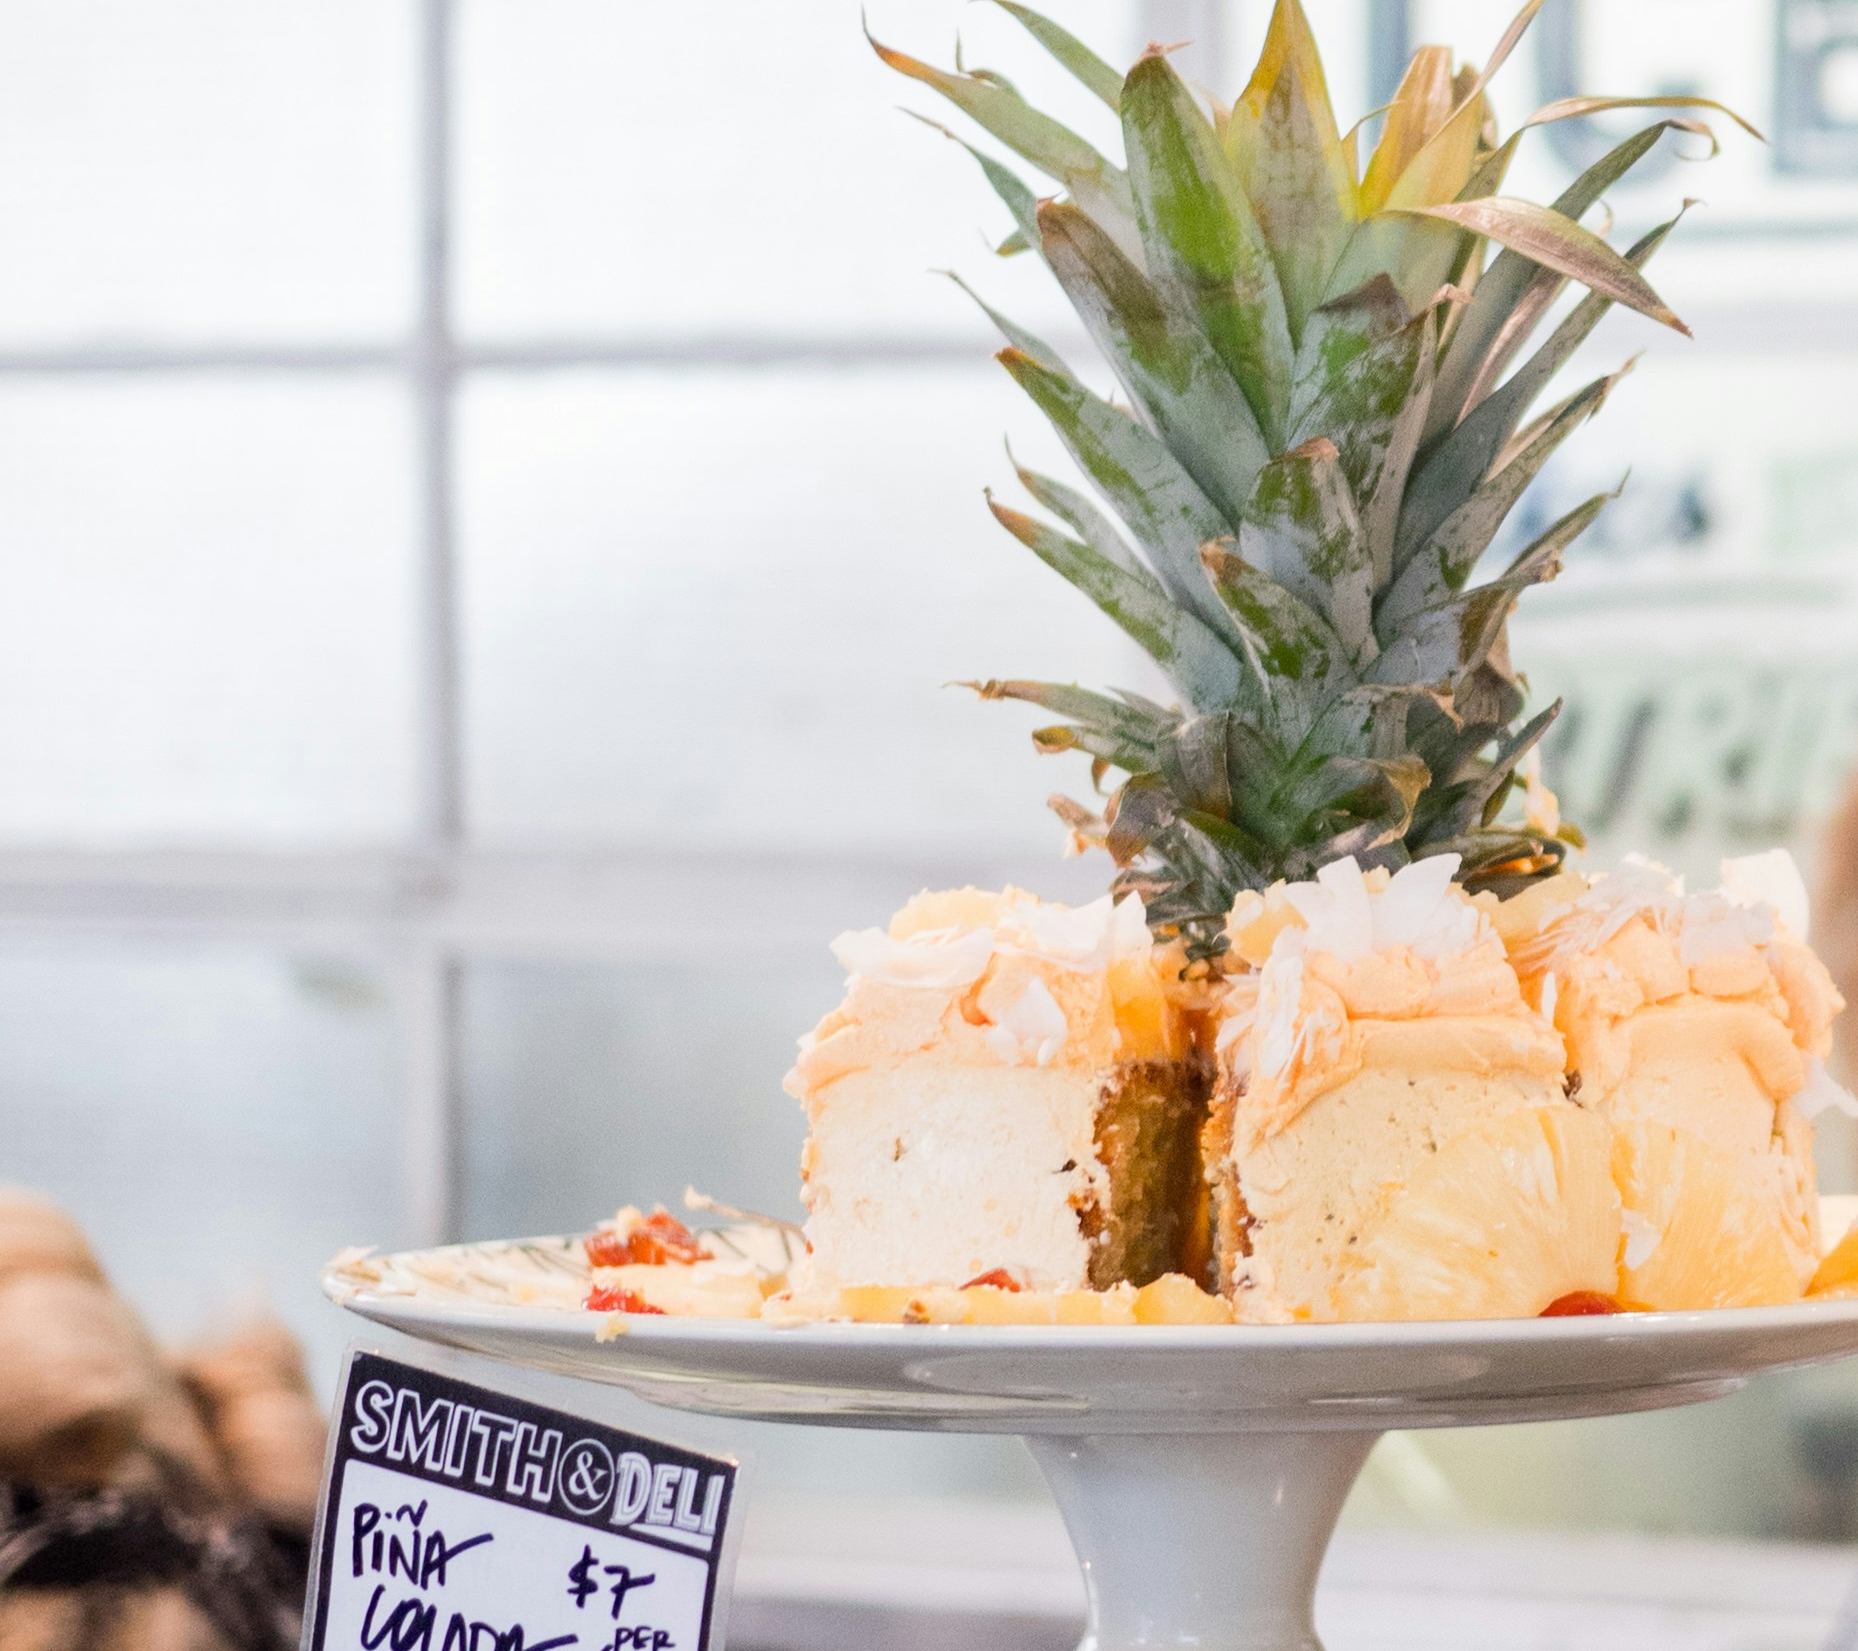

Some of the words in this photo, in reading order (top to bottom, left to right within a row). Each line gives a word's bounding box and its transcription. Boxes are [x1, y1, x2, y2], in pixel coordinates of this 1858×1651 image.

[351, 1379, 564, 1503] SMITH
[609, 1451, 728, 1541] DELI
[566, 1543, 657, 1620] $7
